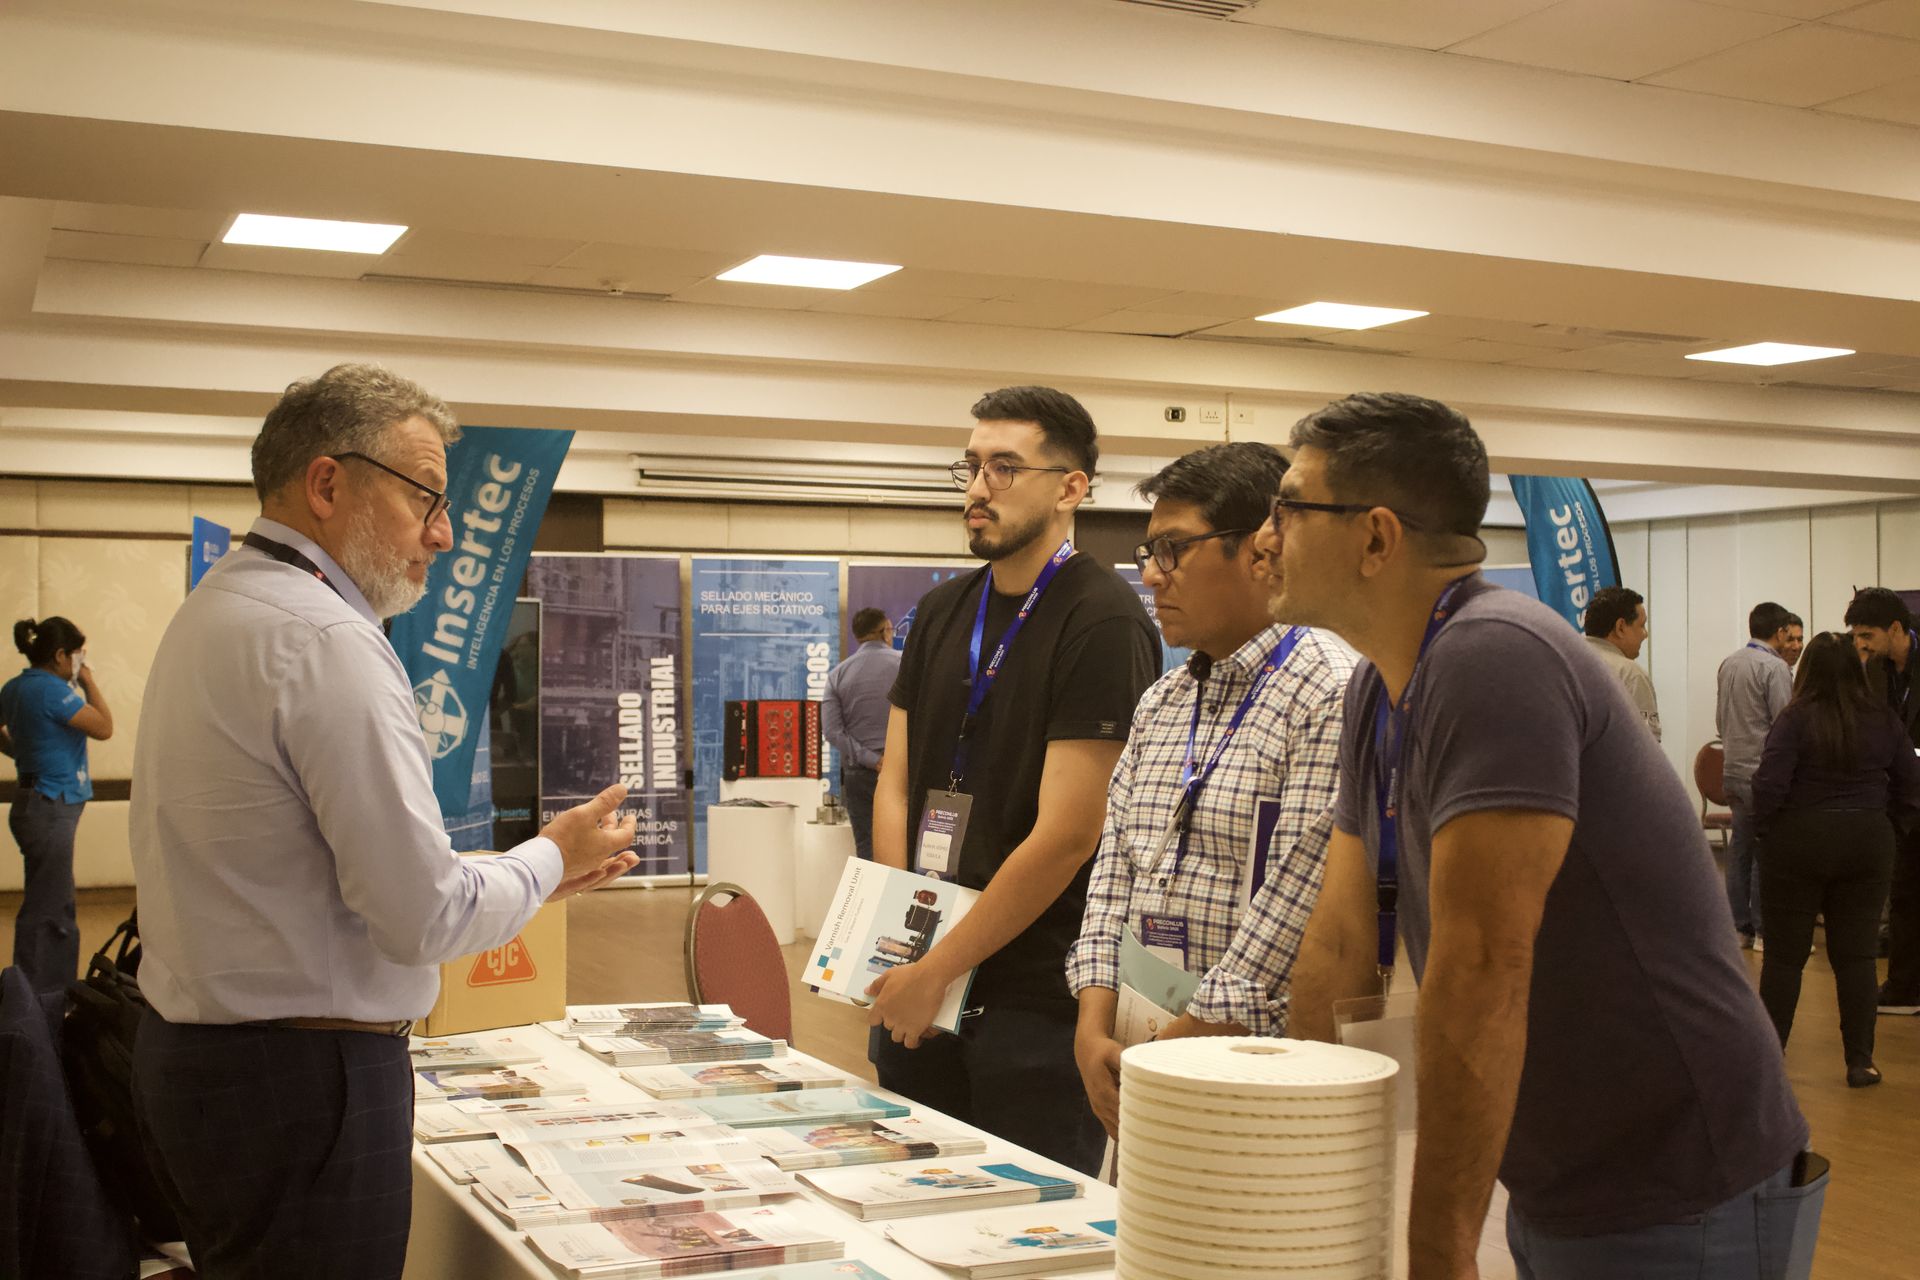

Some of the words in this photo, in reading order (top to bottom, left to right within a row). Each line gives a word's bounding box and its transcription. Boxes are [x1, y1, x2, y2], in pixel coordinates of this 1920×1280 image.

[507, 467, 540, 536] PROCESOS
[1574, 501, 1594, 556] PROCESOS
[422, 454, 522, 664] Insertec
[492, 564, 507, 584] EN
[499, 537, 515, 564] LOS
[1550, 503, 1590, 631] sertec
[1589, 556, 1601, 579] LOS
[700, 591, 752, 601] SELLADO
[701, 604, 731, 614] PARA
[732, 604, 761, 615] EJES
[762, 604, 824, 616] ROTATIVOS
[466, 585, 500, 670] INTELIGENCIA
[618, 692, 644, 789] SELLADO
[650, 654, 677, 788] INDUSTRIAL
[631, 834, 674, 846] ERMICA
[825, 920, 842, 950] Varnish
[837, 885, 855, 921] Removal
[851, 866, 862, 884] Unit
